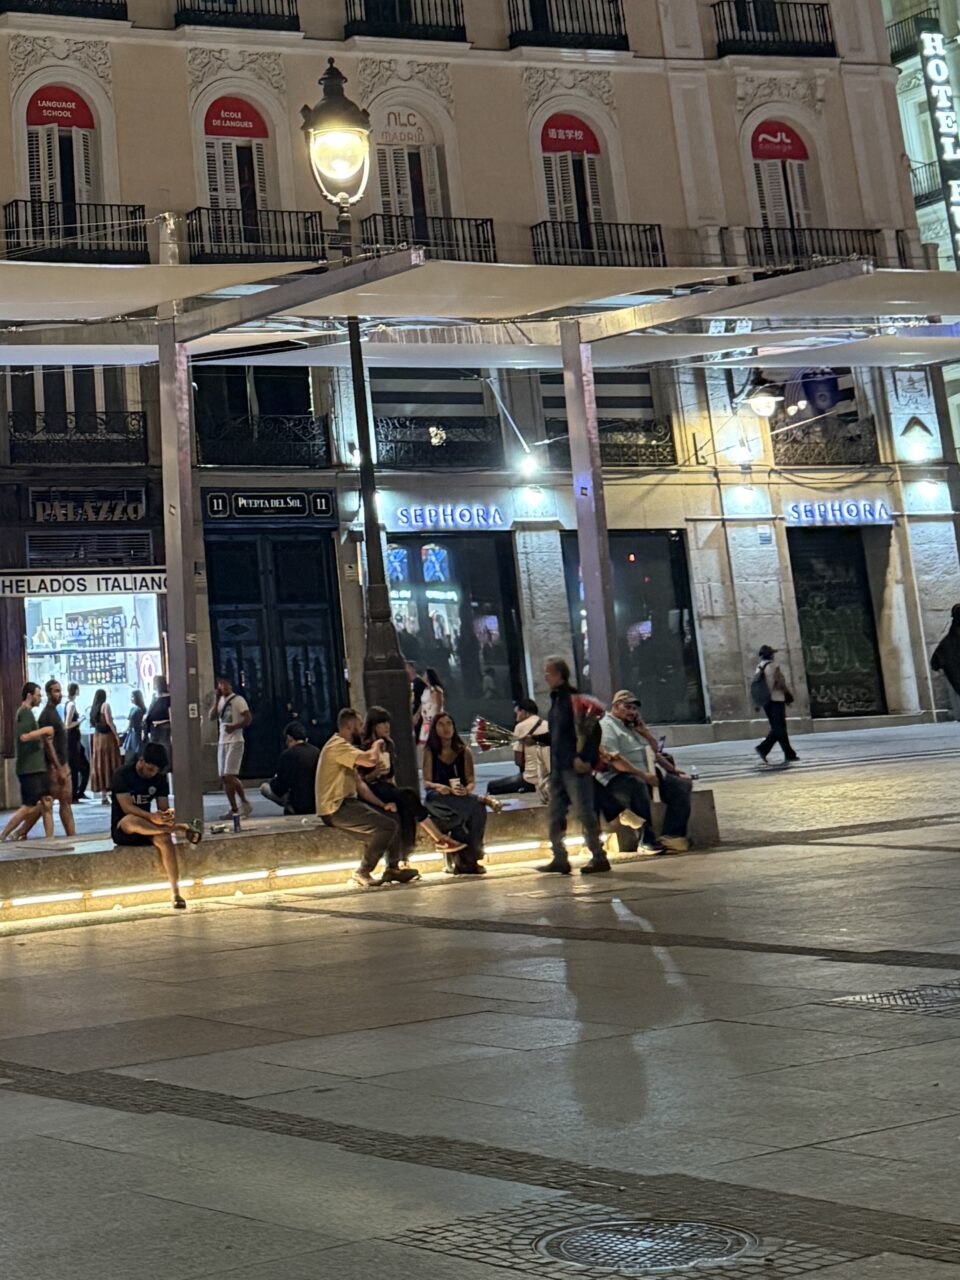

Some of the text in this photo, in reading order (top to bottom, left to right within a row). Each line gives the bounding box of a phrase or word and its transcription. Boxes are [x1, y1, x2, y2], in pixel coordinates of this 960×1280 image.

[920, 31, 960, 160] HOTEL
[37, 100, 76, 109] LANGUAGE
[43, 109, 72, 118] SCHOOL
[35, 500, 146, 522] PALAZZO
[213, 499, 223, 511] 11
[316, 498, 327, 510] 11
[791, 503, 890, 520] SEPHORA
[399, 507, 504, 525] SEPHORA
[2, 578, 87, 594] HELADOS
